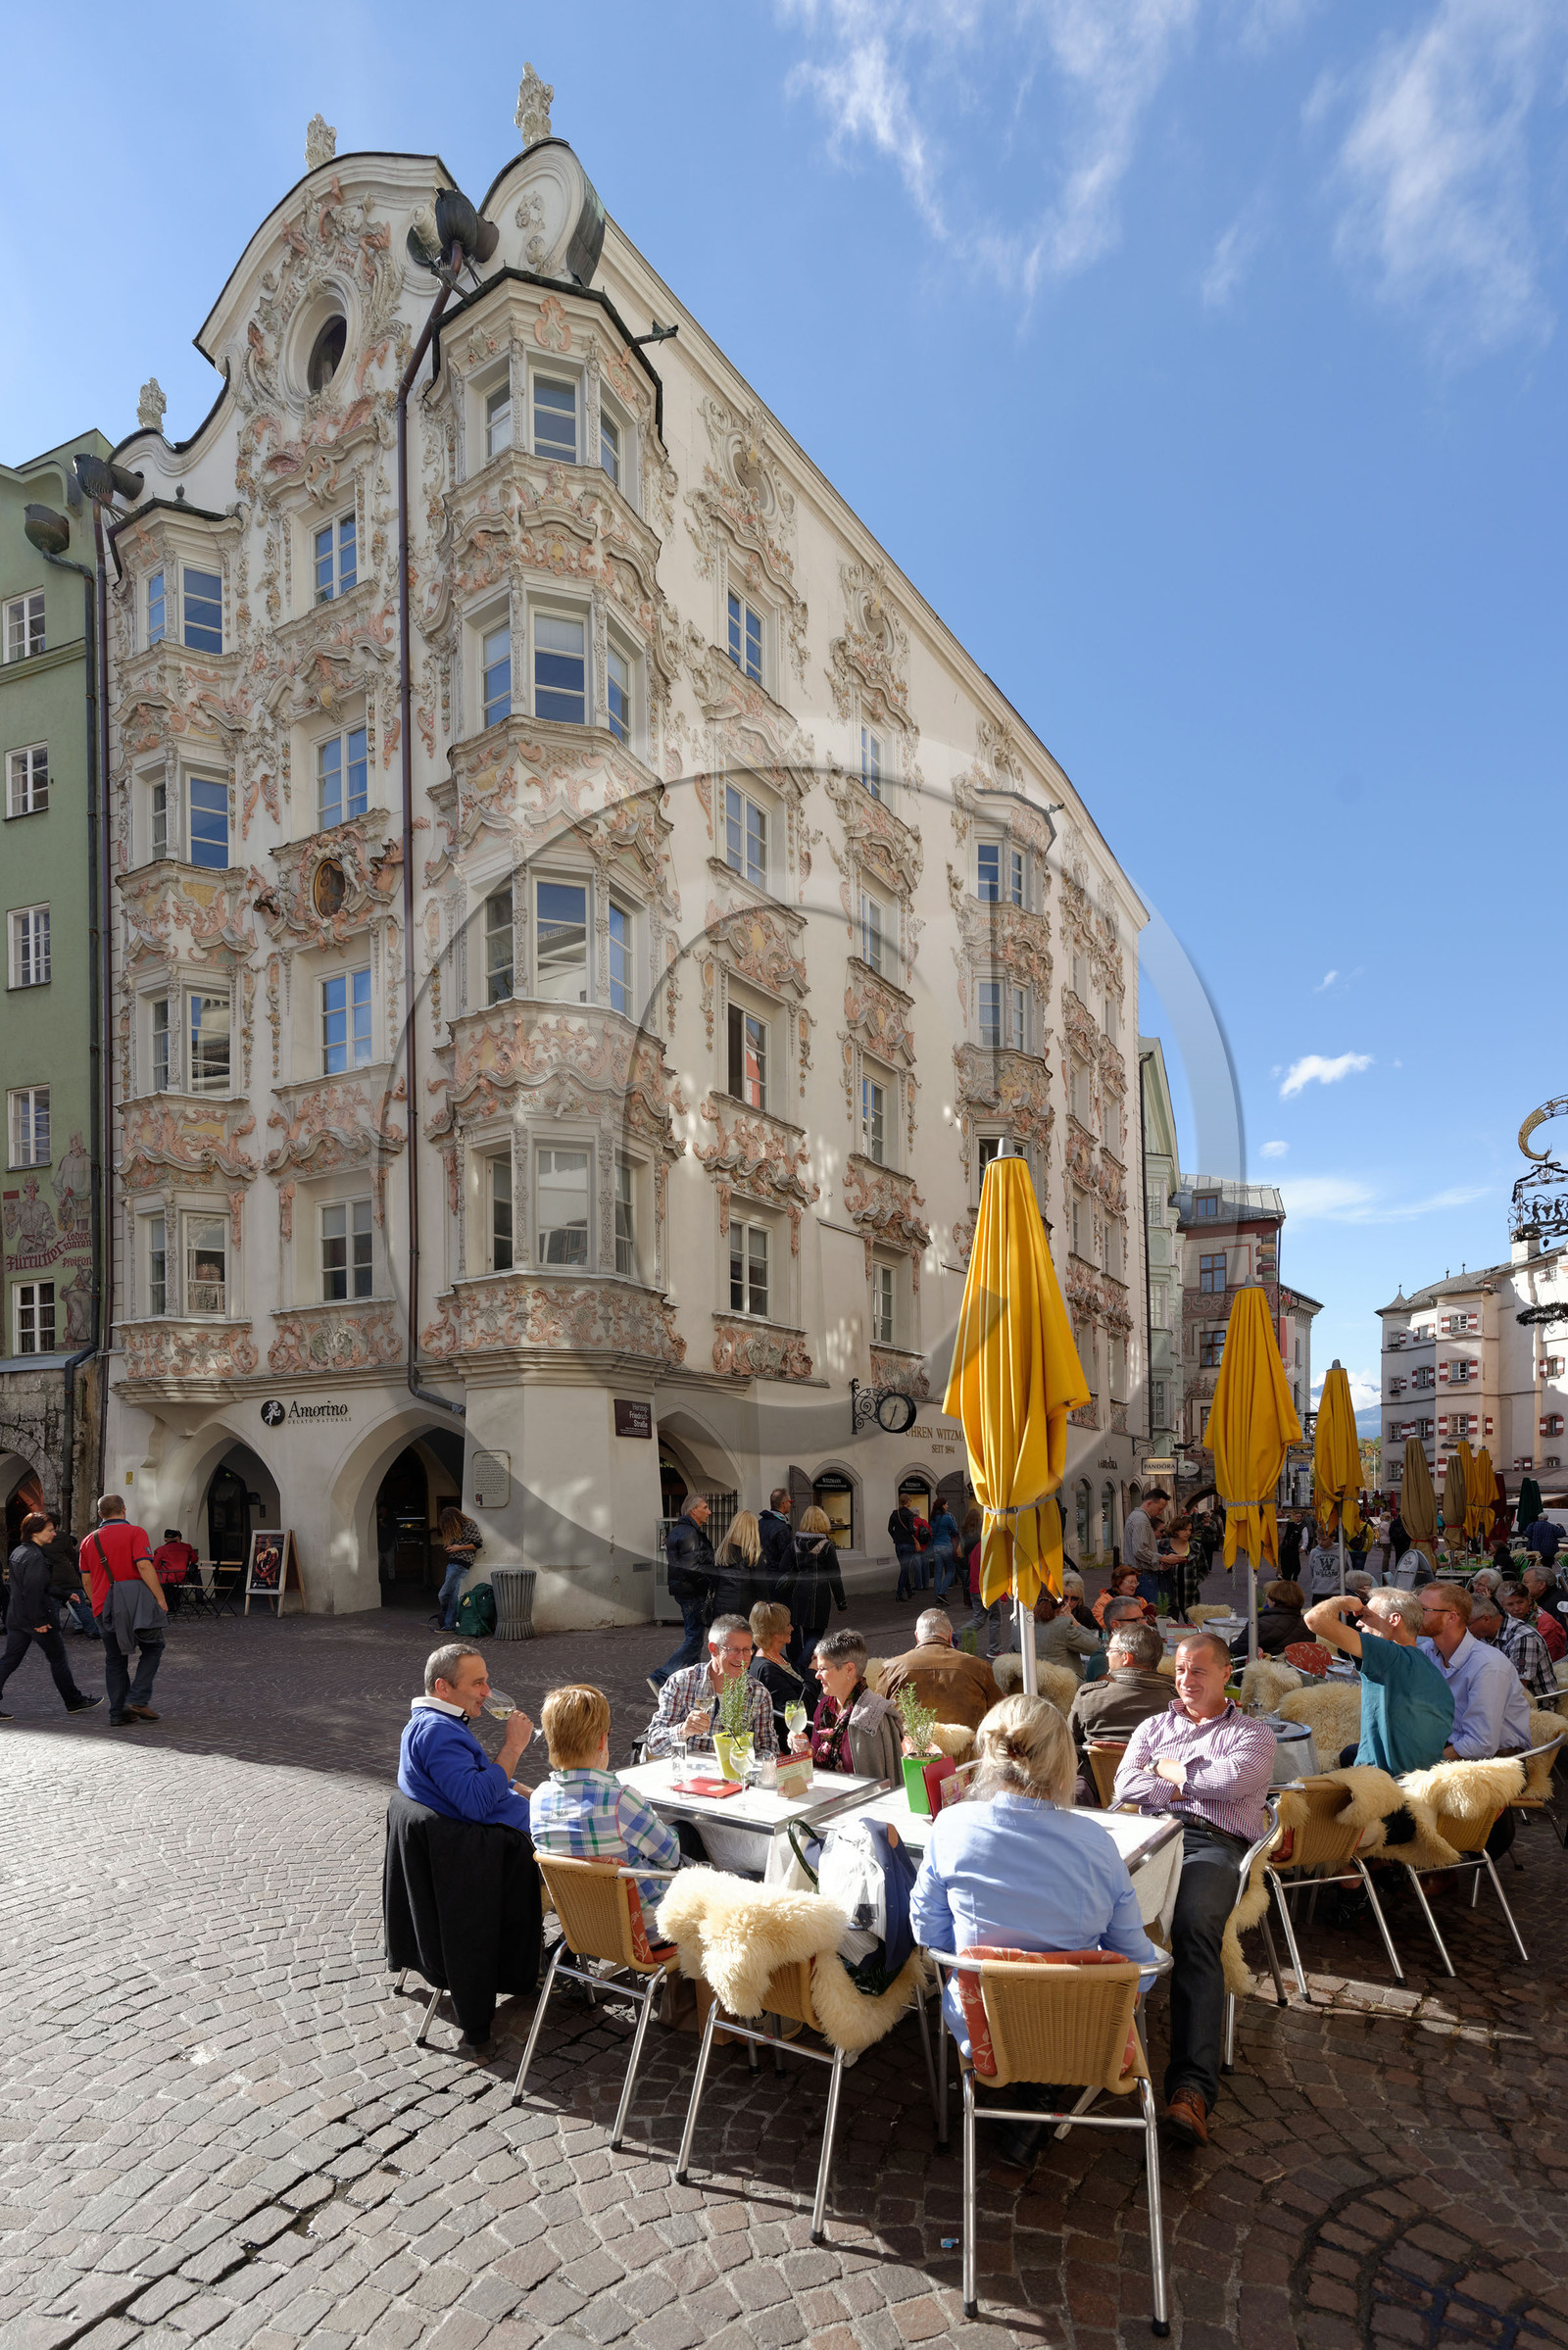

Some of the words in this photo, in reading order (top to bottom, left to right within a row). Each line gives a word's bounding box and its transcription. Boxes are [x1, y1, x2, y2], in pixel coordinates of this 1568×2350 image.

[288, 1400, 348, 1418] Amorino
[633, 1419, 648, 1428] Straße
[936, 1428, 965, 1442] WITZM
[932, 1444, 945, 1453] SEIT
